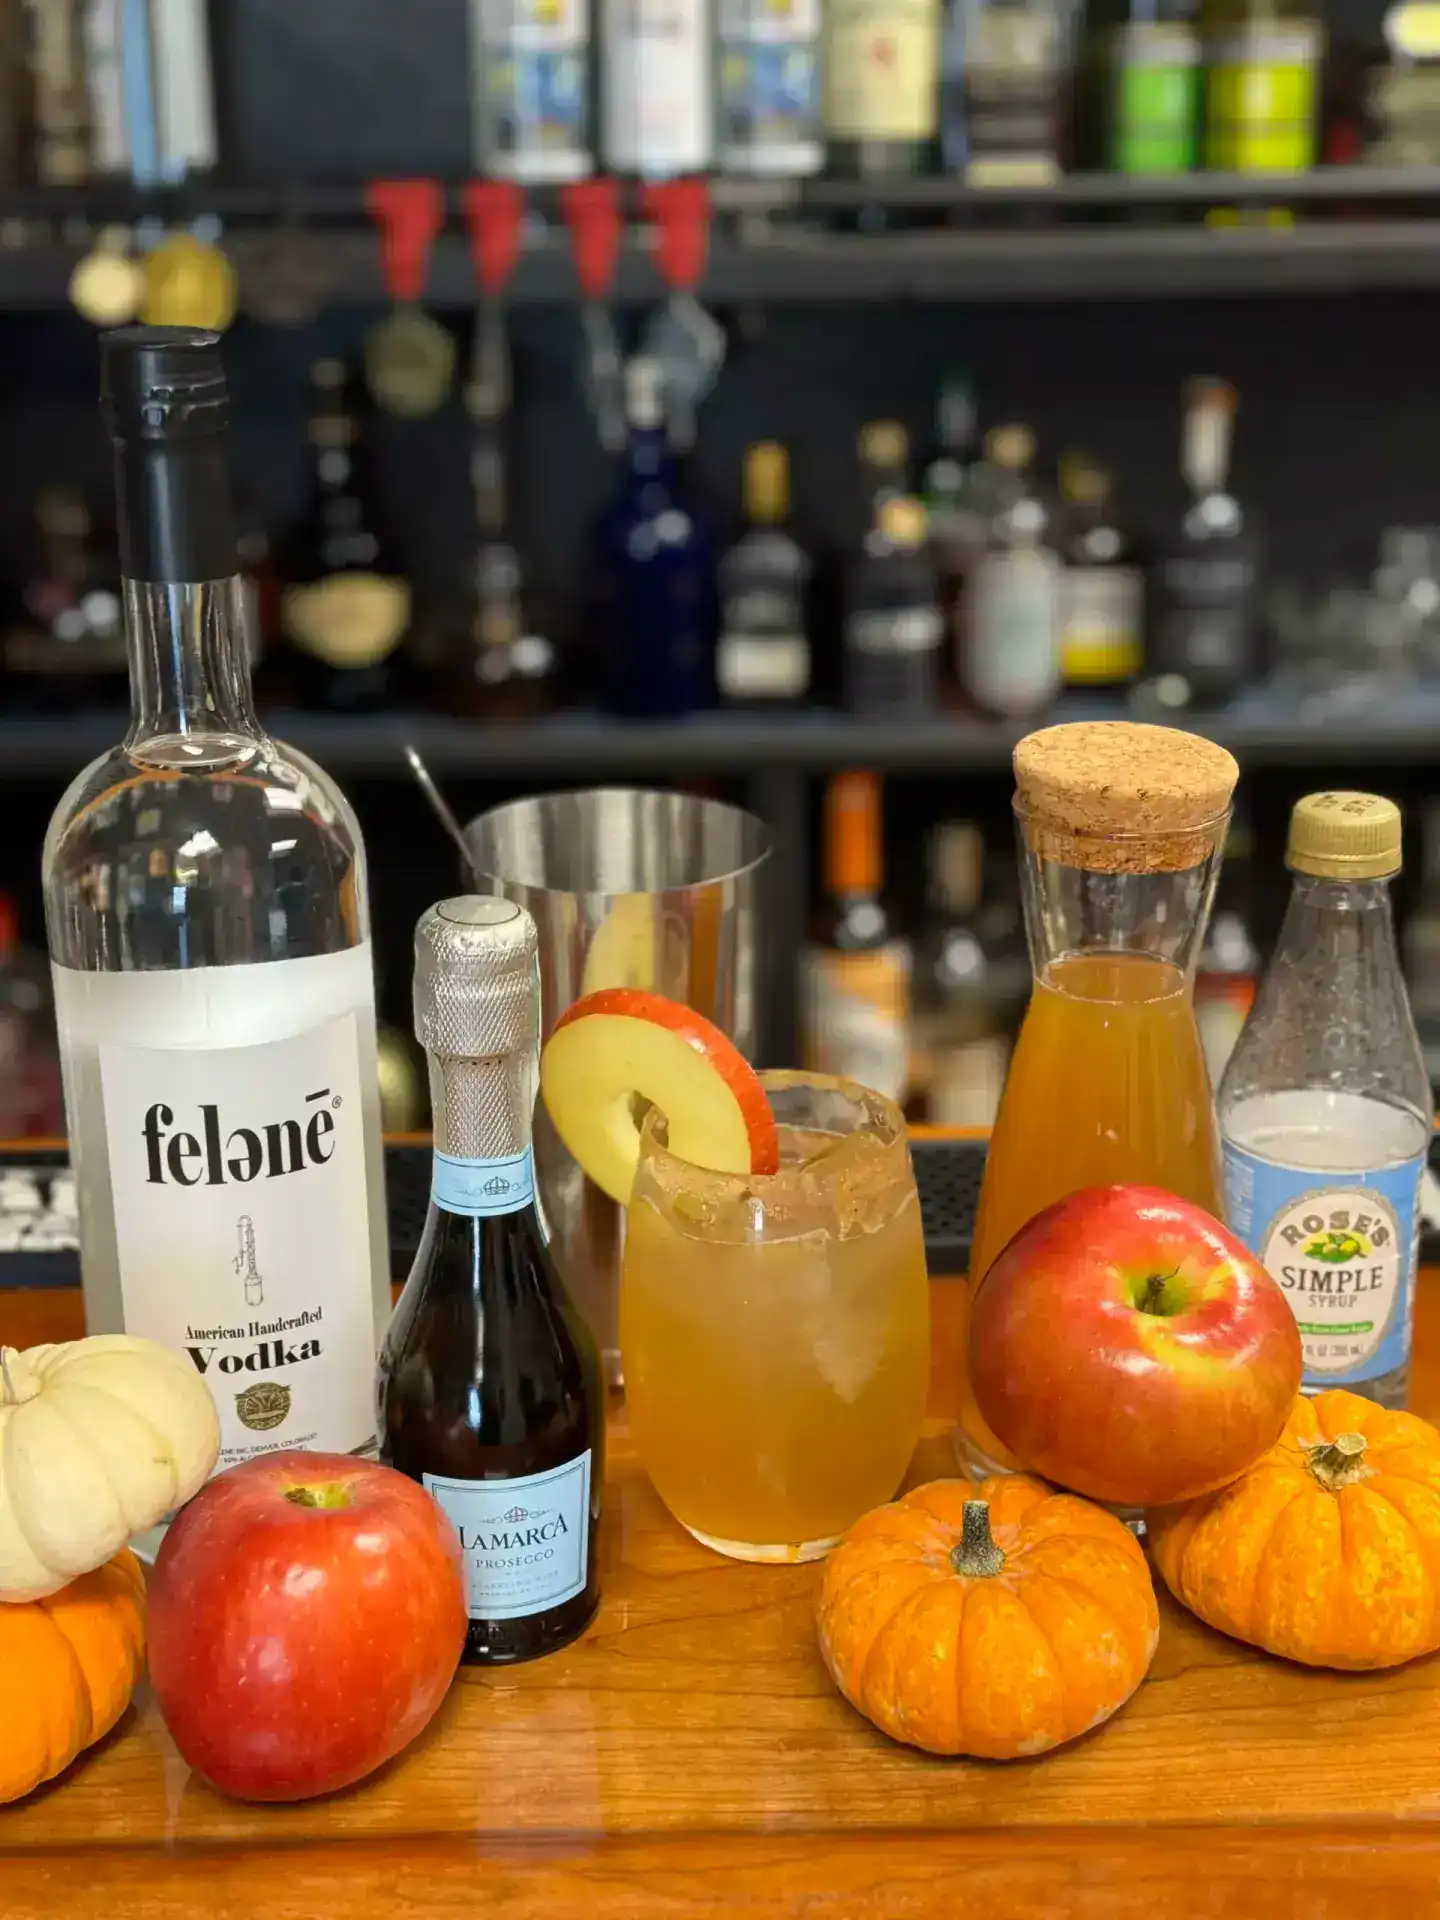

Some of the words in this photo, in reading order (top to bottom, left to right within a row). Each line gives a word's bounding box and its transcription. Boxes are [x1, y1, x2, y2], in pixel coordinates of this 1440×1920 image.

[1279, 1210, 1390, 1248] ROSE'S
[1280, 1266, 1384, 1293] SIMPLE
[1308, 1294, 1358, 1308] SYRUP
[185, 1325, 245, 1340] American
[248, 1306, 323, 1337] Handcrafted
[182, 1339, 324, 1374] Vodka
[475, 1548, 554, 1569] PROSECCO
